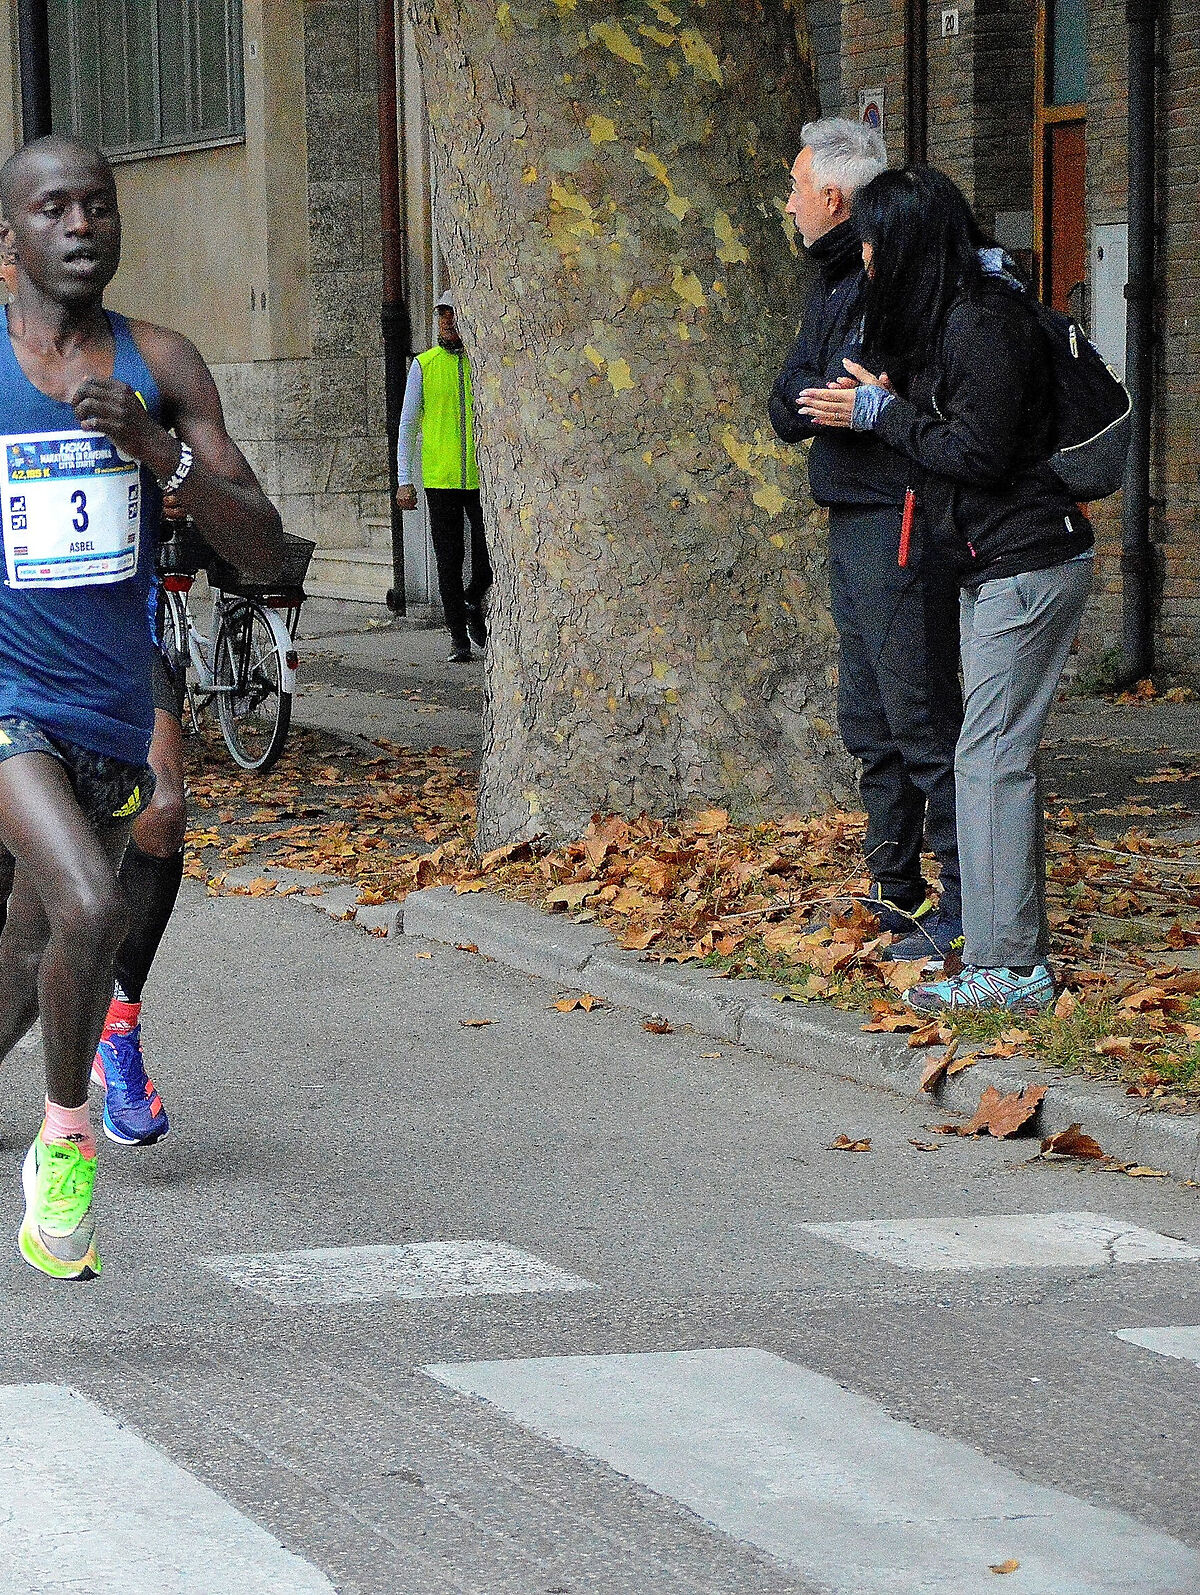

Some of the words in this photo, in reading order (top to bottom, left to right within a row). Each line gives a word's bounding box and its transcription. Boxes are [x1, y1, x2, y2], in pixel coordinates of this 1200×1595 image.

[945, 14, 955, 32] 20
[59, 442, 92, 454] HOKA
[70, 489, 89, 533] 3
[69, 541, 95, 554] ASBEL
